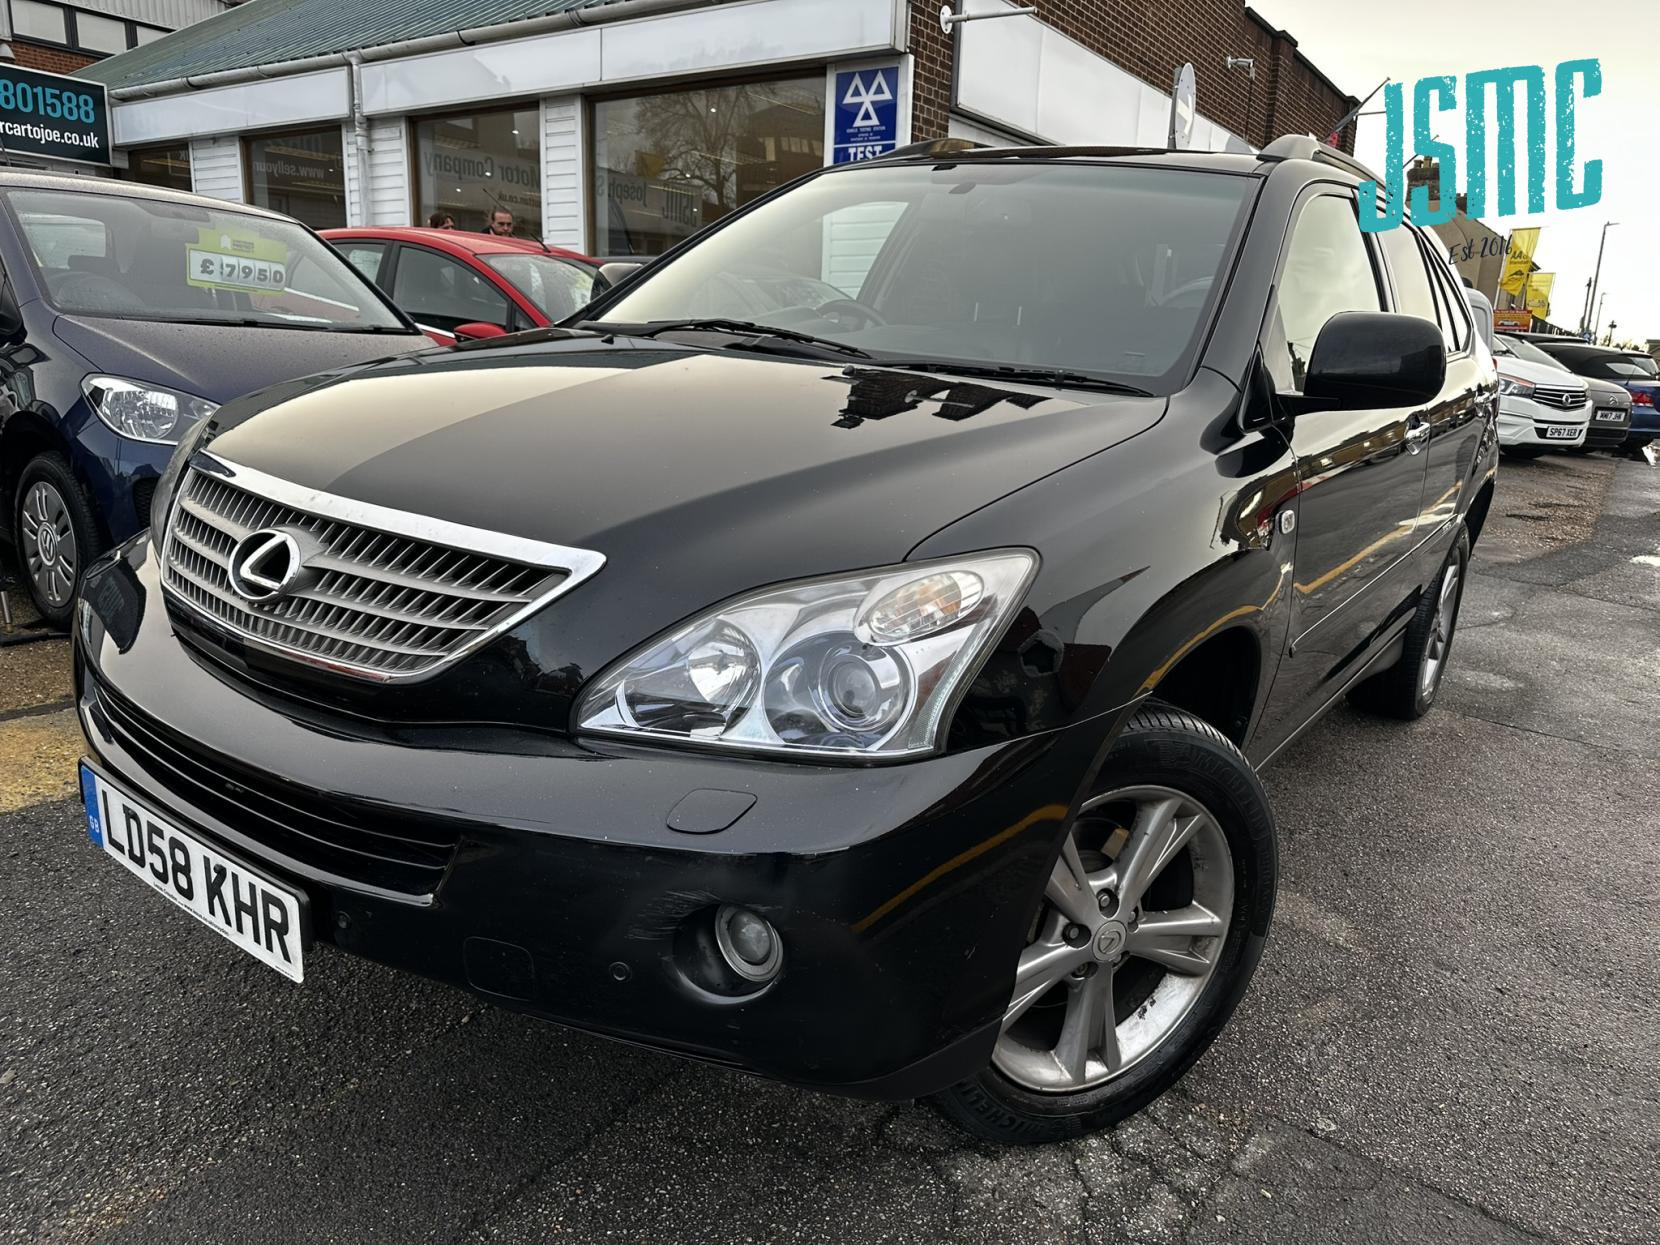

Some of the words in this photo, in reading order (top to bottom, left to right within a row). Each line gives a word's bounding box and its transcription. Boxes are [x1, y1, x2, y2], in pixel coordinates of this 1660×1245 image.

[0, 79, 96, 124] 801588
[848, 145, 883, 162] TEST
[1549, 427, 1566, 437] SP67
[1566, 428, 1578, 437] XER
[89, 815, 100, 833] GB
[101, 789, 194, 901] LD58
[203, 855, 292, 964] KHR
